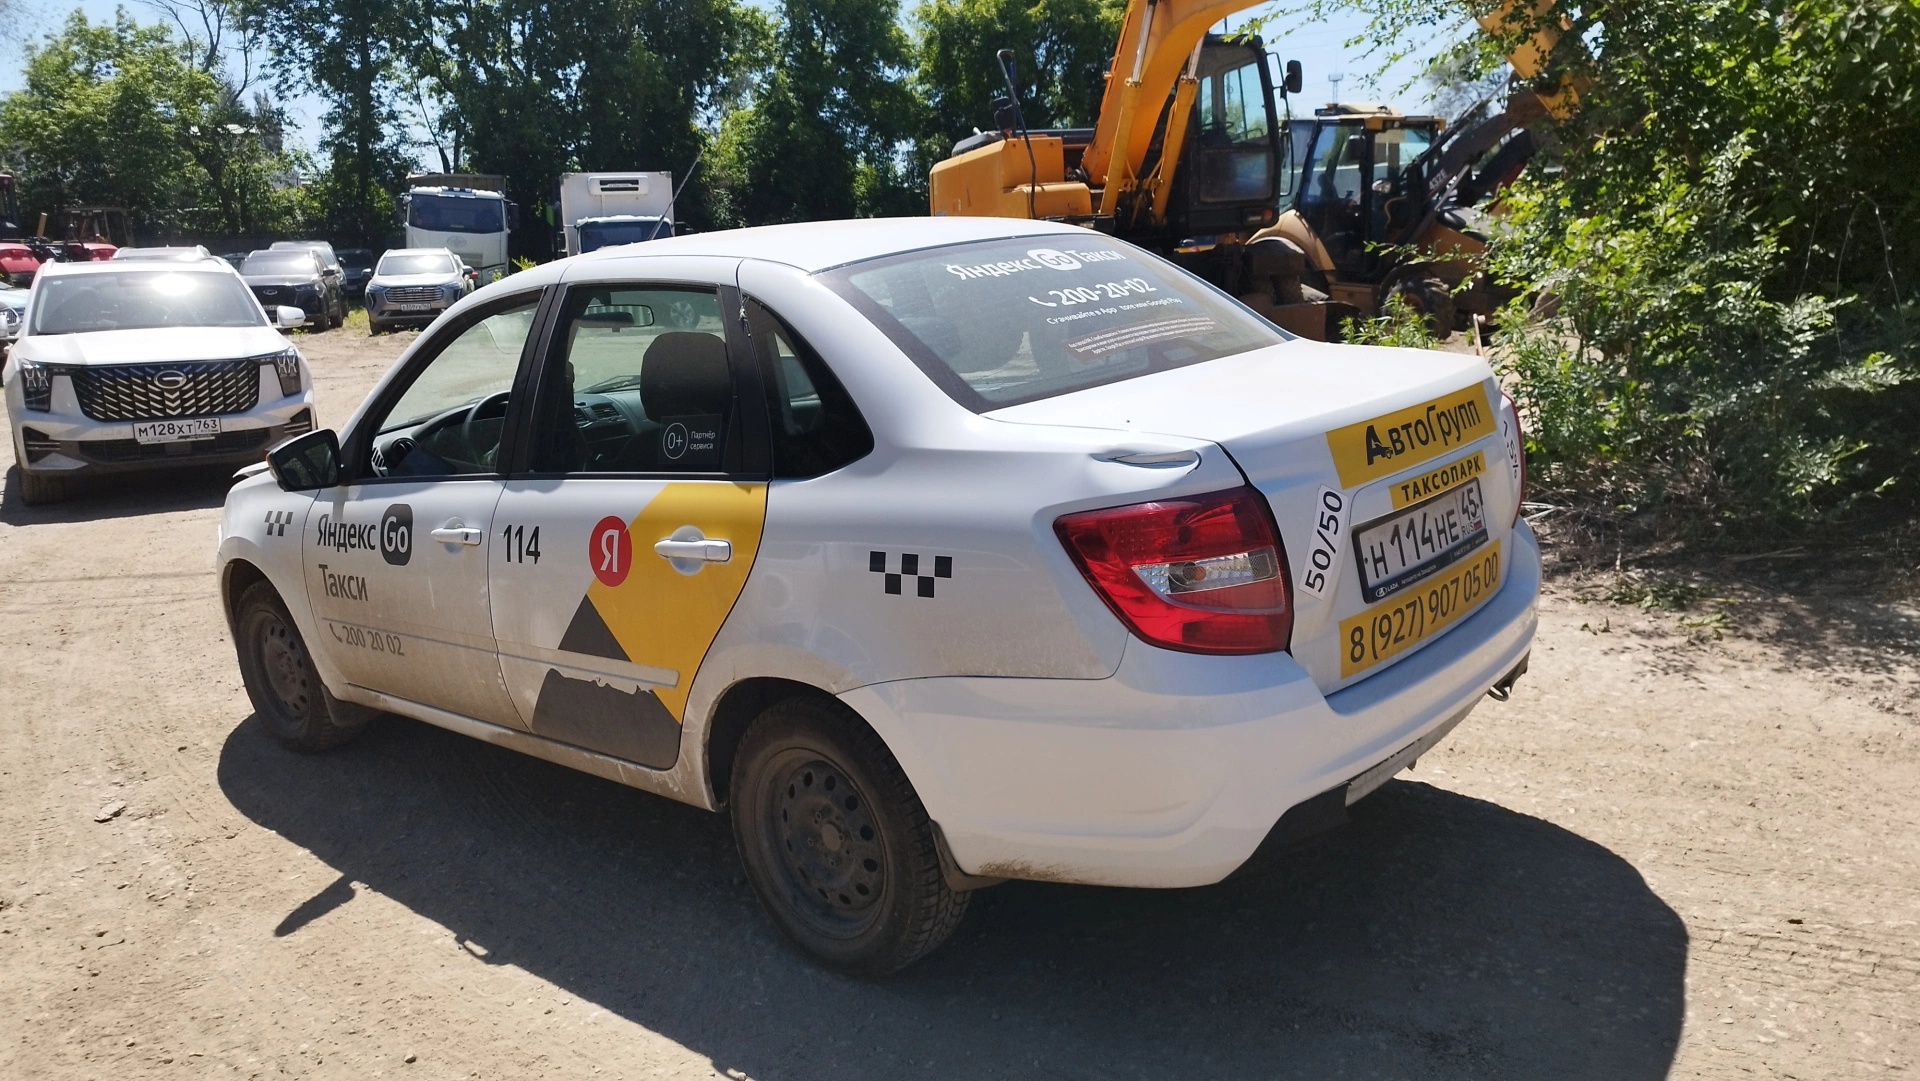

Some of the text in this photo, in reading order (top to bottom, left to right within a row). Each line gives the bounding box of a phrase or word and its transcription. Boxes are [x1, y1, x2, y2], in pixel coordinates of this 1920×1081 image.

[946, 258, 1042, 281] Яндекс
[1064, 250, 1127, 263] Такси
[1050, 278, 1157, 305] 200-20-02
[1046, 311, 1096, 325] Скачивайте
[1100, 307, 1117, 315] App
[195, 420, 218, 430] 763
[667, 432, 683, 450] 0+
[690, 430, 716, 440] Партнёр
[1365, 399, 1481, 466] АвтоГрупп
[690, 442, 714, 451] сервиса
[1401, 455, 1481, 502] ТАКСОПАРК
[1461, 487, 1477, 521] 45
[317, 513, 409, 553] Яндекс Go
[503, 524, 541, 565] 114
[1305, 490, 1343, 593] 50/50
[1462, 521, 1475, 536] RUS
[599, 527, 619, 573] Я
[318, 563, 369, 601] Такси
[1350, 551, 1498, 663] 8 (927) 907 05 00
[342, 625, 405, 657] 200 20 02
